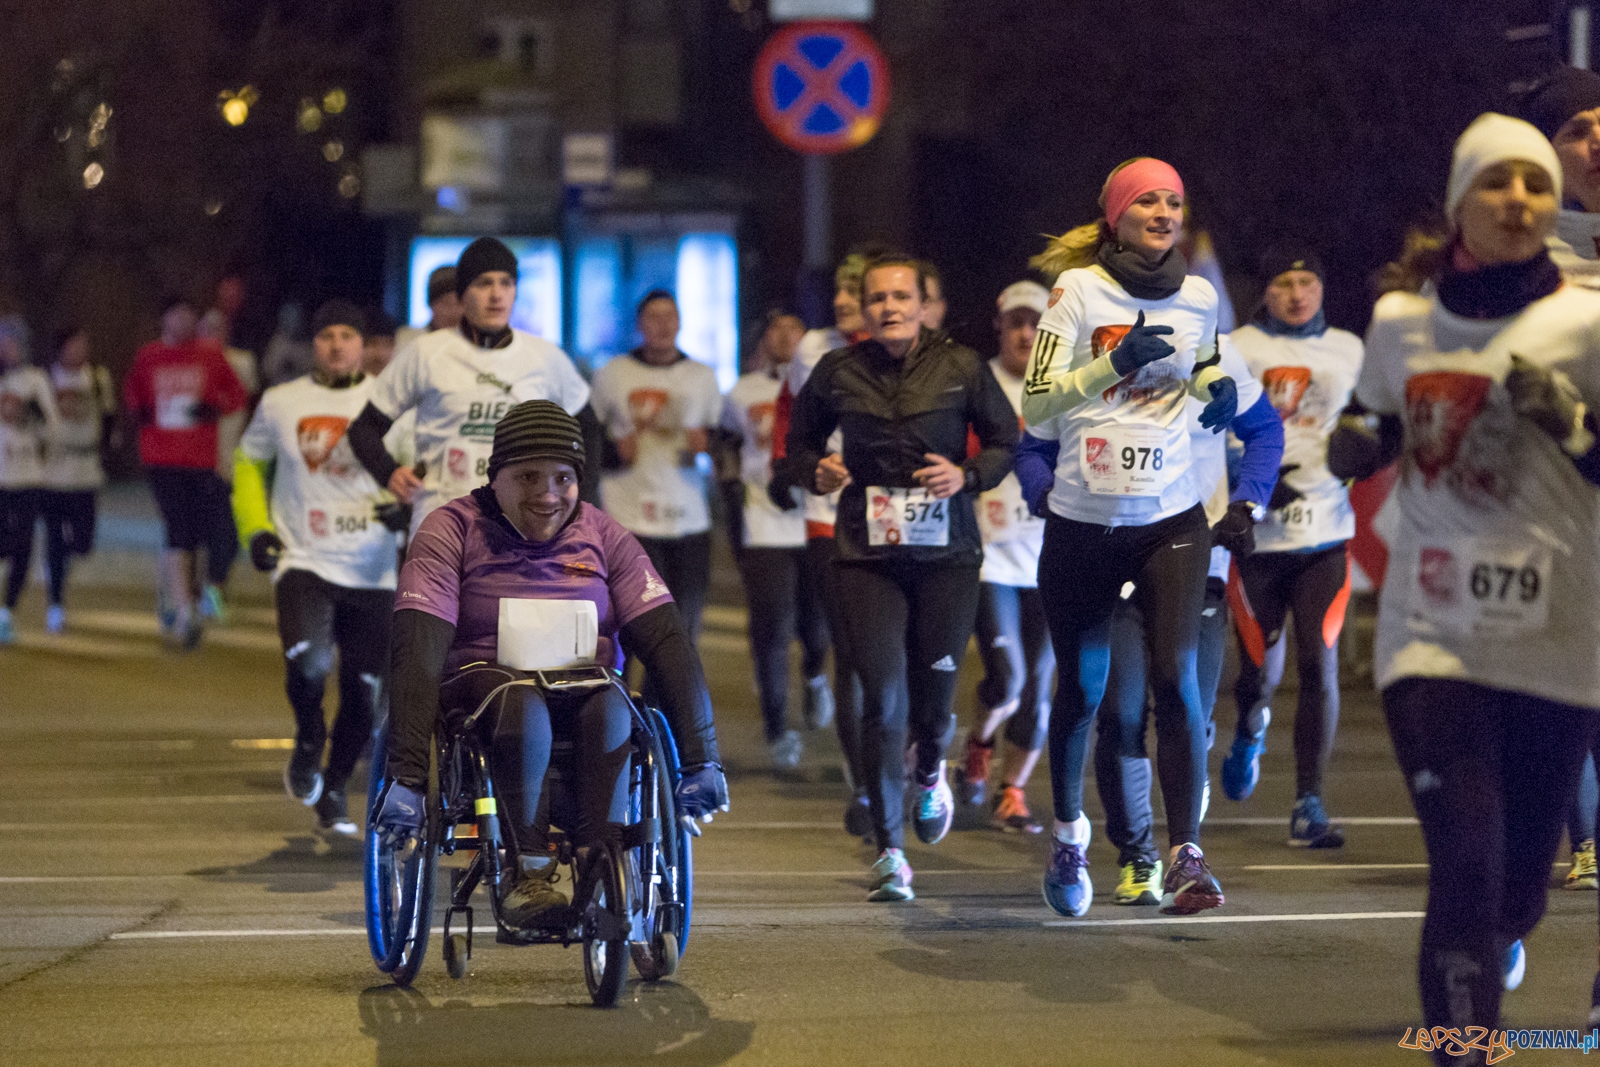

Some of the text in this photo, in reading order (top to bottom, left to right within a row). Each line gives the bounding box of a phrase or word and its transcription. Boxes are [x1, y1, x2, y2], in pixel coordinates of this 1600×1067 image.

[1121, 447, 1163, 471] 978
[904, 502, 943, 522] 574
[335, 516, 367, 533] 504
[1470, 562, 1539, 604] 679
